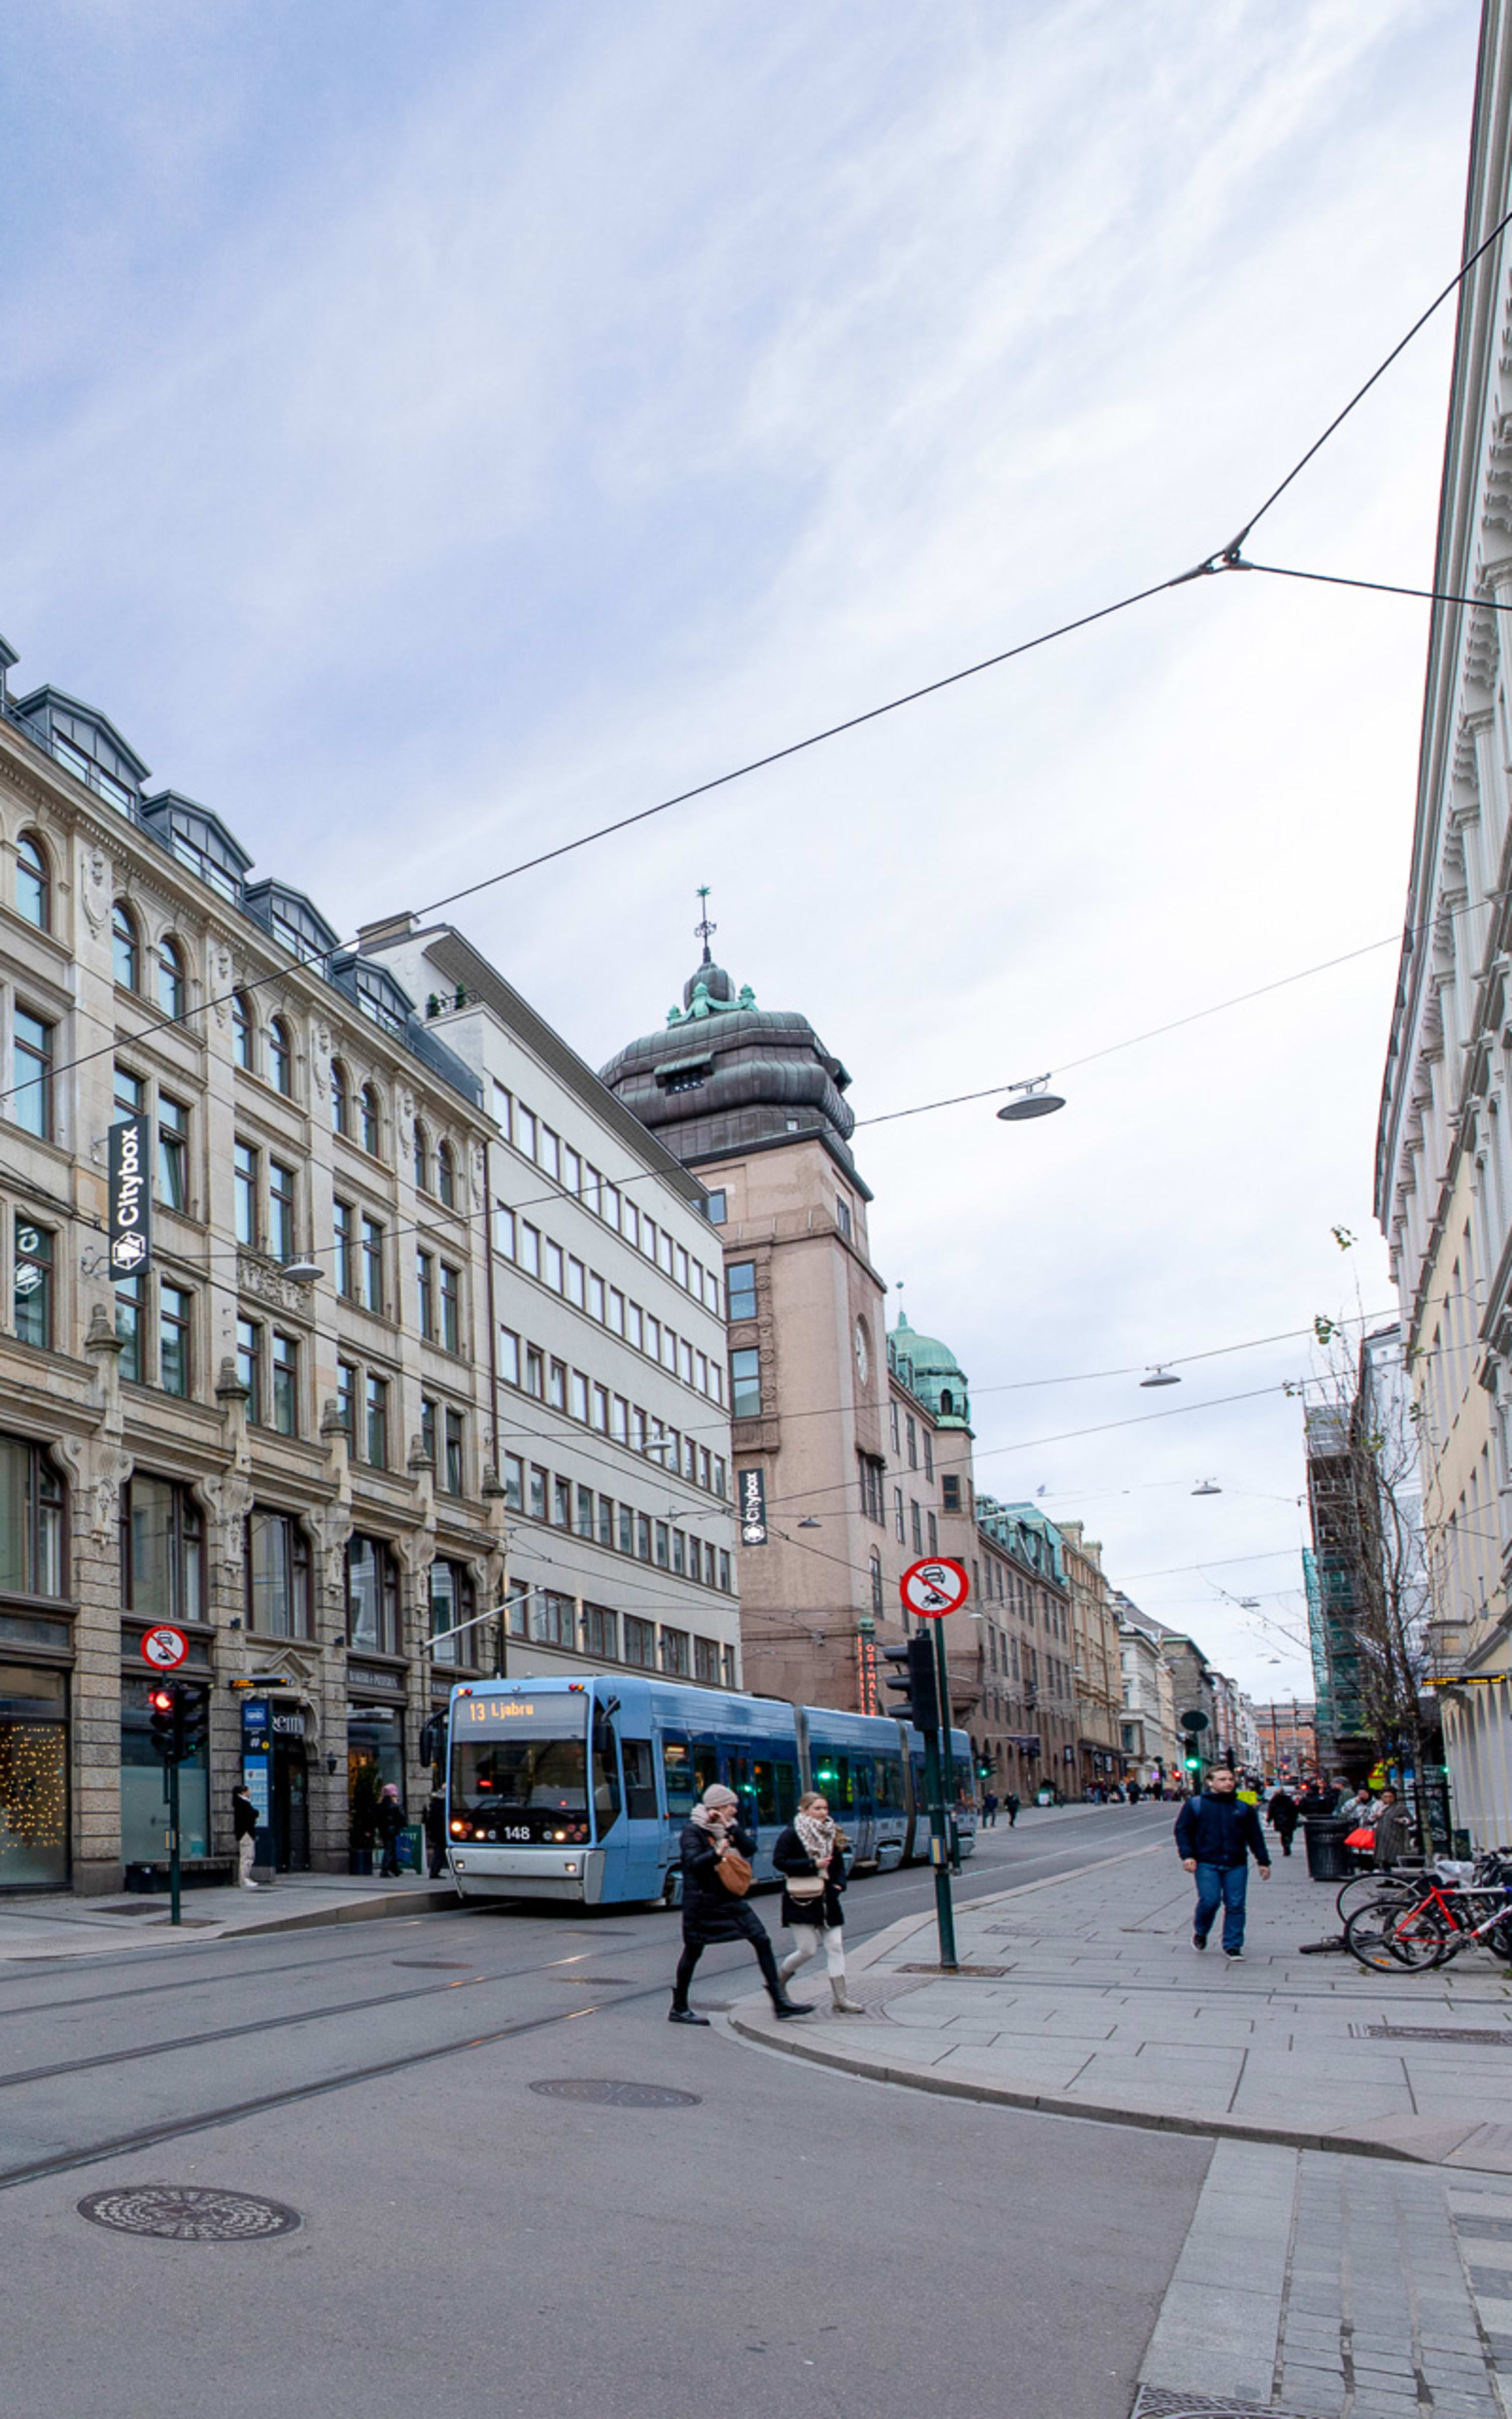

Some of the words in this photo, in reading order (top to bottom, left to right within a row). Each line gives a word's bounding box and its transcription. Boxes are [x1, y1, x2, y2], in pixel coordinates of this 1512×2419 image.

[118, 1126, 144, 1226] Citybox
[745, 1472, 762, 1521] Citybox
[470, 1703, 485, 1721] 13
[491, 1702, 534, 1720] Ljabru
[504, 1826, 530, 1839] 148
